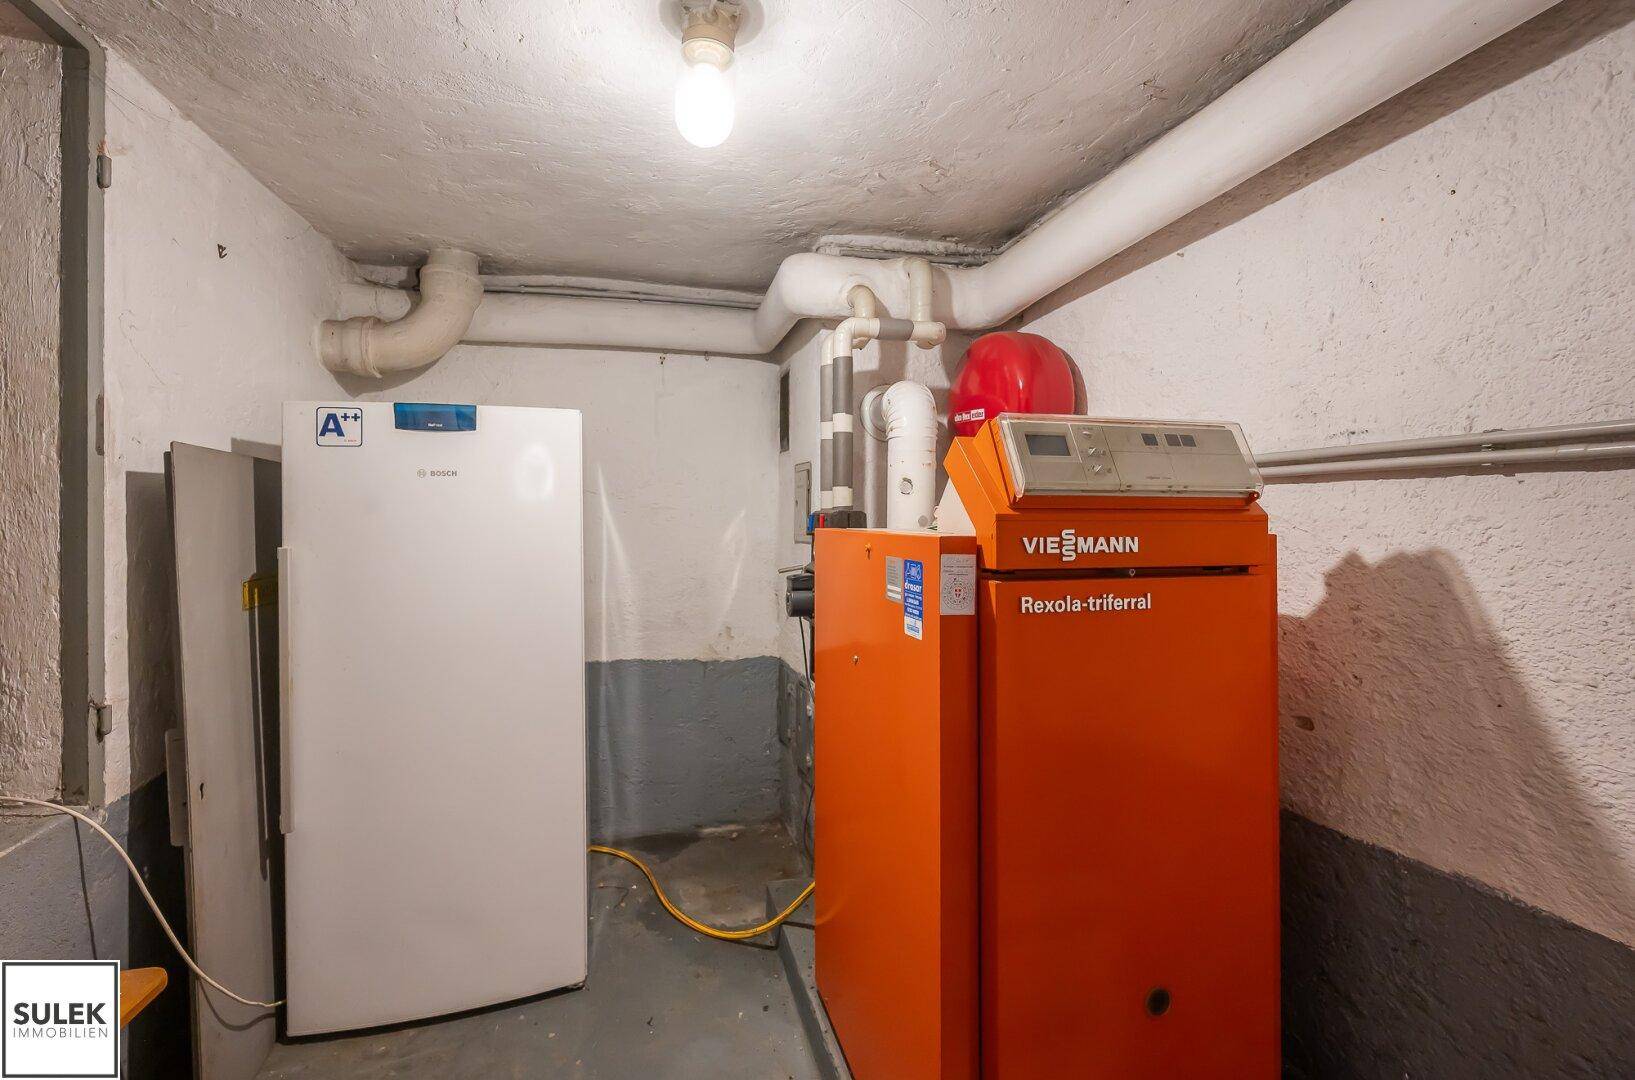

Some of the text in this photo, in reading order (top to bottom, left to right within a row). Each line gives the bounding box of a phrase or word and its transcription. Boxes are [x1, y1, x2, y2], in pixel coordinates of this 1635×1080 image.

[319, 413, 361, 437] A++
[1022, 529, 1139, 561] VIESSMANN
[1021, 593, 1152, 613] Rexola-triferral
